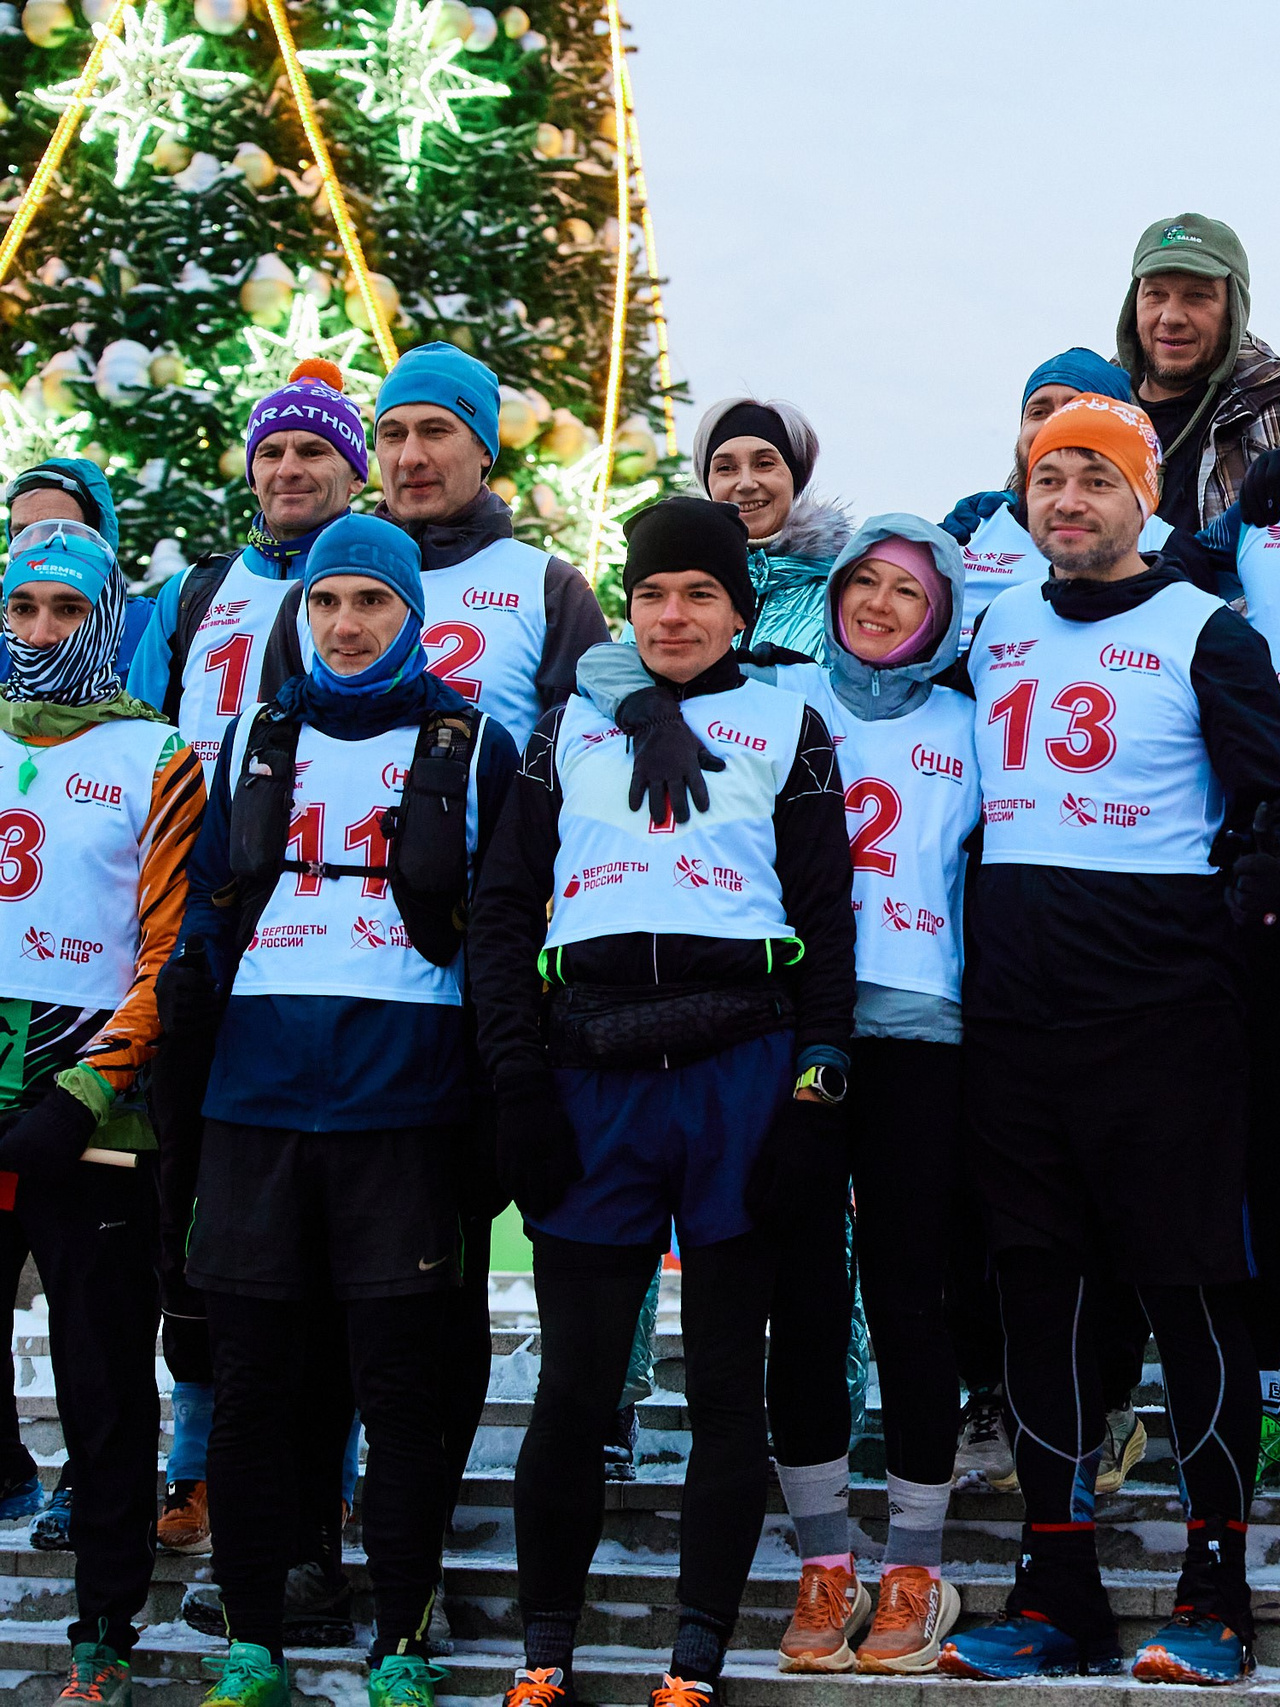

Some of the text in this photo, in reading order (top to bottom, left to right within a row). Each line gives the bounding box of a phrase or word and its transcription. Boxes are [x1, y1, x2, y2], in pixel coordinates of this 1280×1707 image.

[34, 564, 83, 580] GERMES
[471, 591, 519, 608] НЦВ
[421, 620, 486, 704] 2
[1108, 648, 1160, 671] НЦВ
[205, 633, 254, 716] 1
[988, 679, 1117, 773] 13
[717, 726, 766, 751] НЦВ
[920, 750, 963, 778] НЦВ
[74, 778, 121, 805] НЦВ
[1104, 803, 1150, 816] ППОО
[844, 777, 902, 877] 2
[1104, 814, 1137, 828] НЦВ
[0, 808, 46, 902] 3
[288, 803, 392, 899] 11
[583, 862, 649, 879] ВЕРТОЛЕТЫ
[584, 874, 623, 891] РОССИИ
[262, 925, 327, 936] ВЕРТОЛЕТЫ
[62, 937, 103, 954] ППОО
[261, 937, 304, 948] РОССИИ
[60, 949, 90, 964] НЦВ
